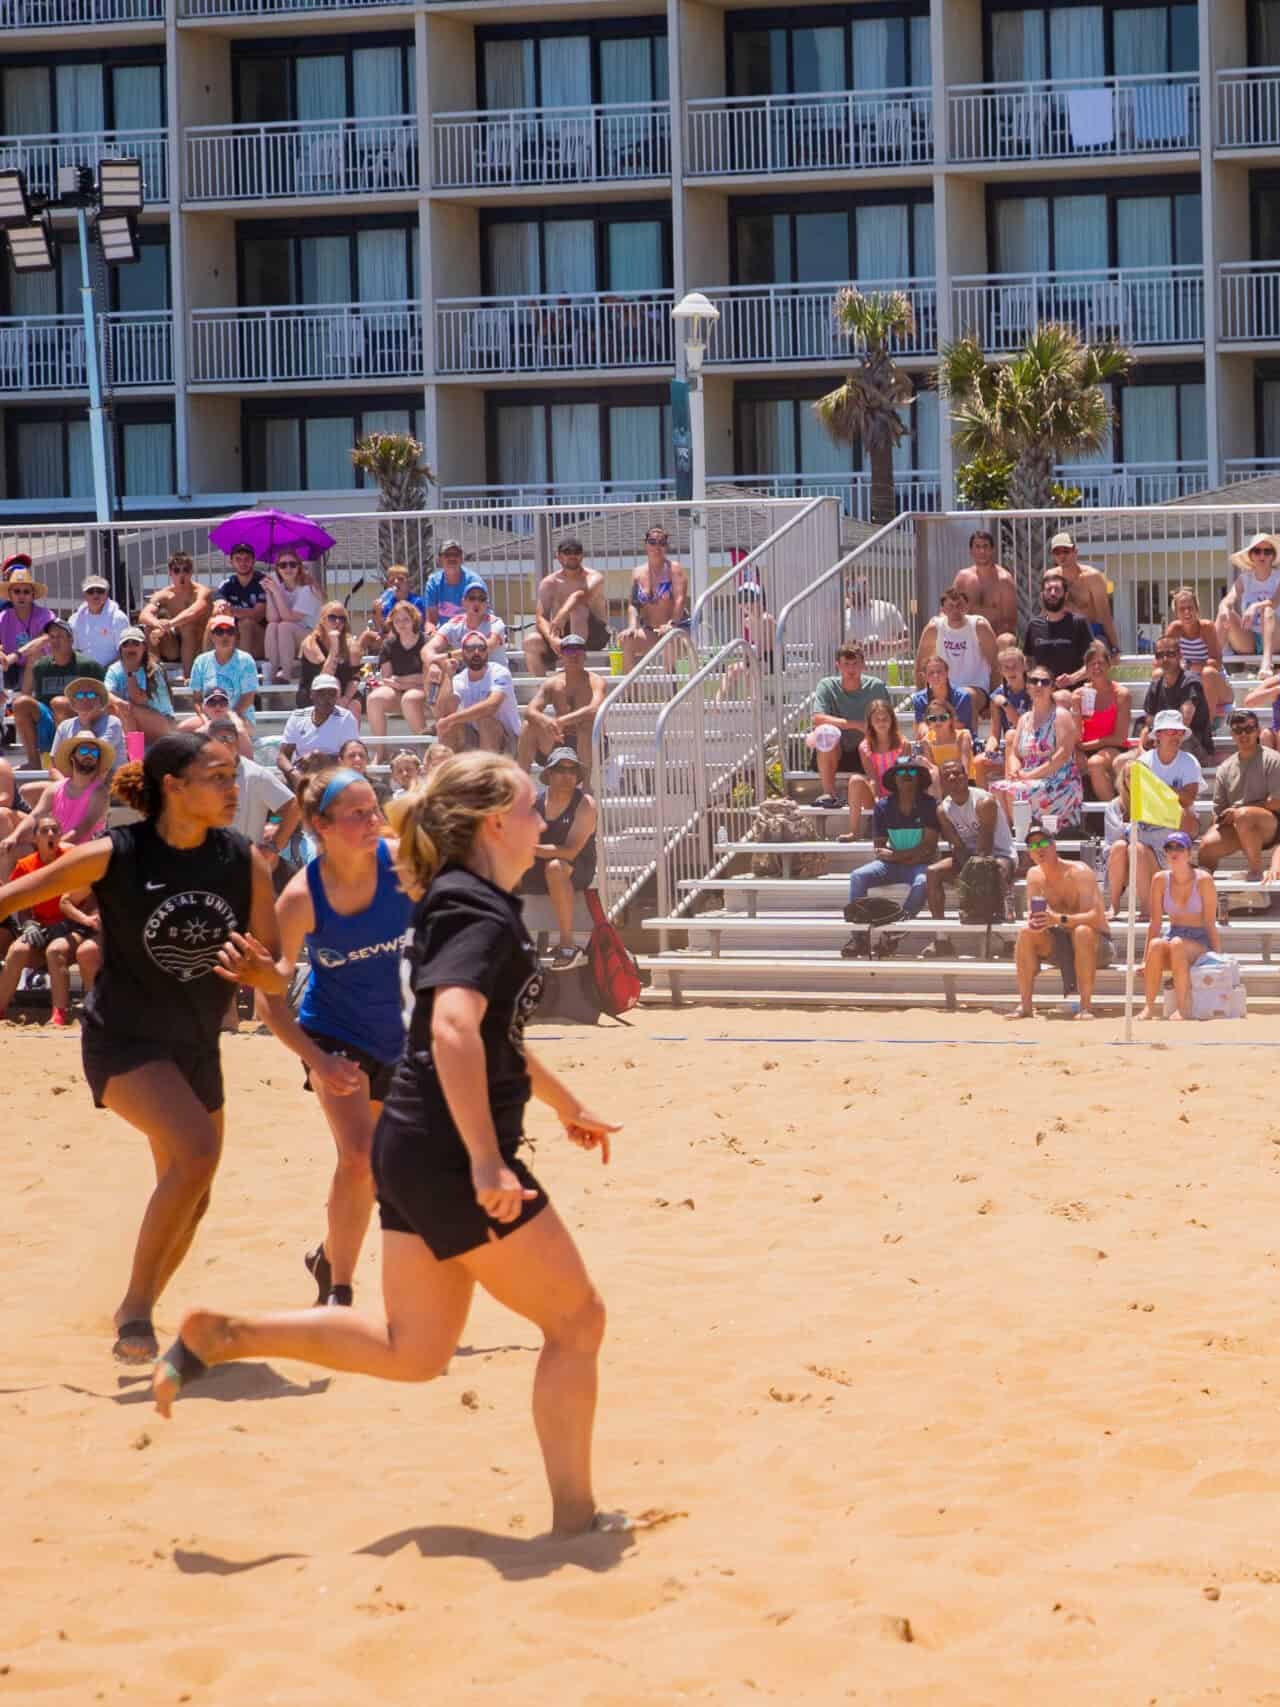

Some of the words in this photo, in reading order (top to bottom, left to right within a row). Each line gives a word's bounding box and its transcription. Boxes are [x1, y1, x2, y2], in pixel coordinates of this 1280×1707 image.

[144, 895, 197, 938] COASAL
[205, 895, 239, 929] UNITE
[348, 935, 408, 961] SEVWS
